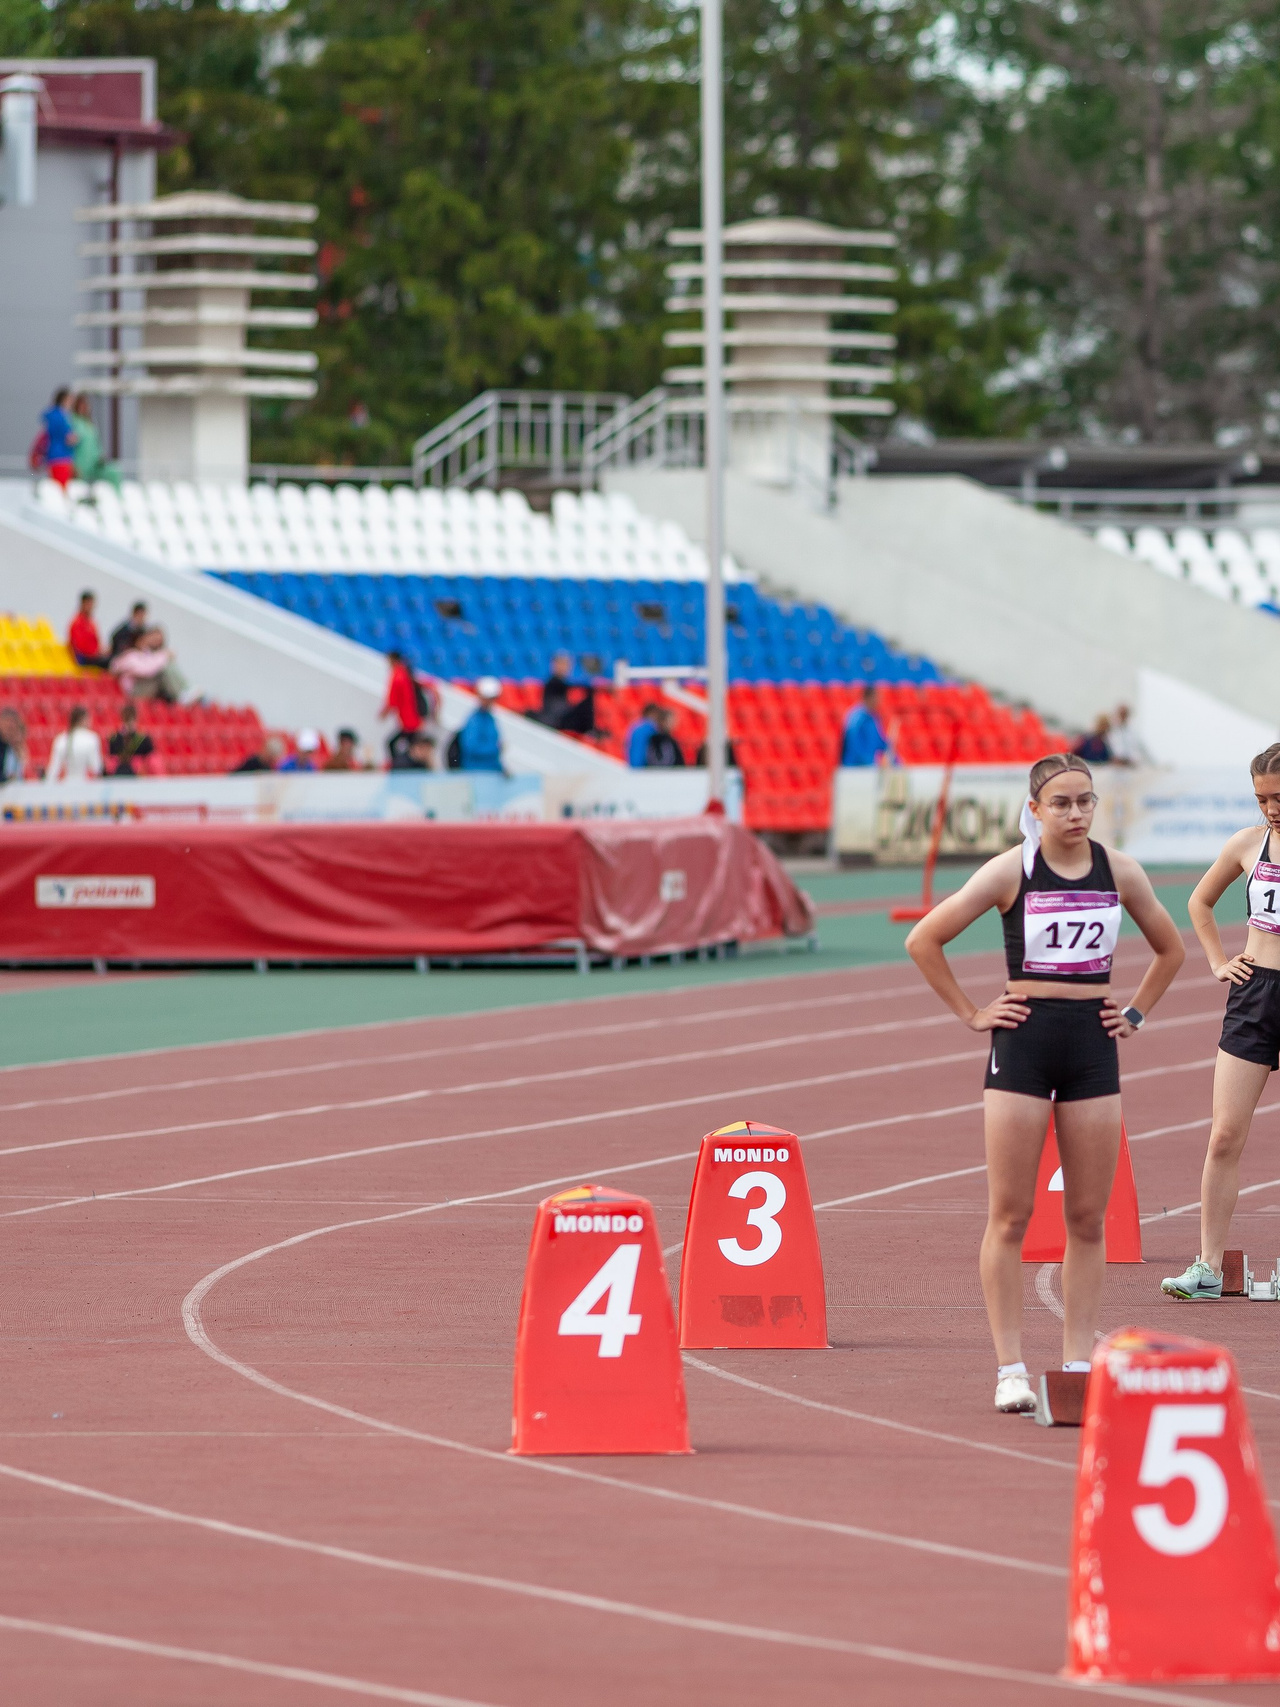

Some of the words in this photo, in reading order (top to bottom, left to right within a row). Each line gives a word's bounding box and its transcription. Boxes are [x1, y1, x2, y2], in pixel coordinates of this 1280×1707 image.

[1045, 921, 1105, 949] 172
[714, 1148, 790, 1163] MONDO
[554, 1214, 644, 1233] MONDO
[717, 1170, 787, 1267] 3
[557, 1243, 643, 1358] 4
[1118, 1366, 1228, 1394] MONDO
[1131, 1403, 1230, 1557] 5
